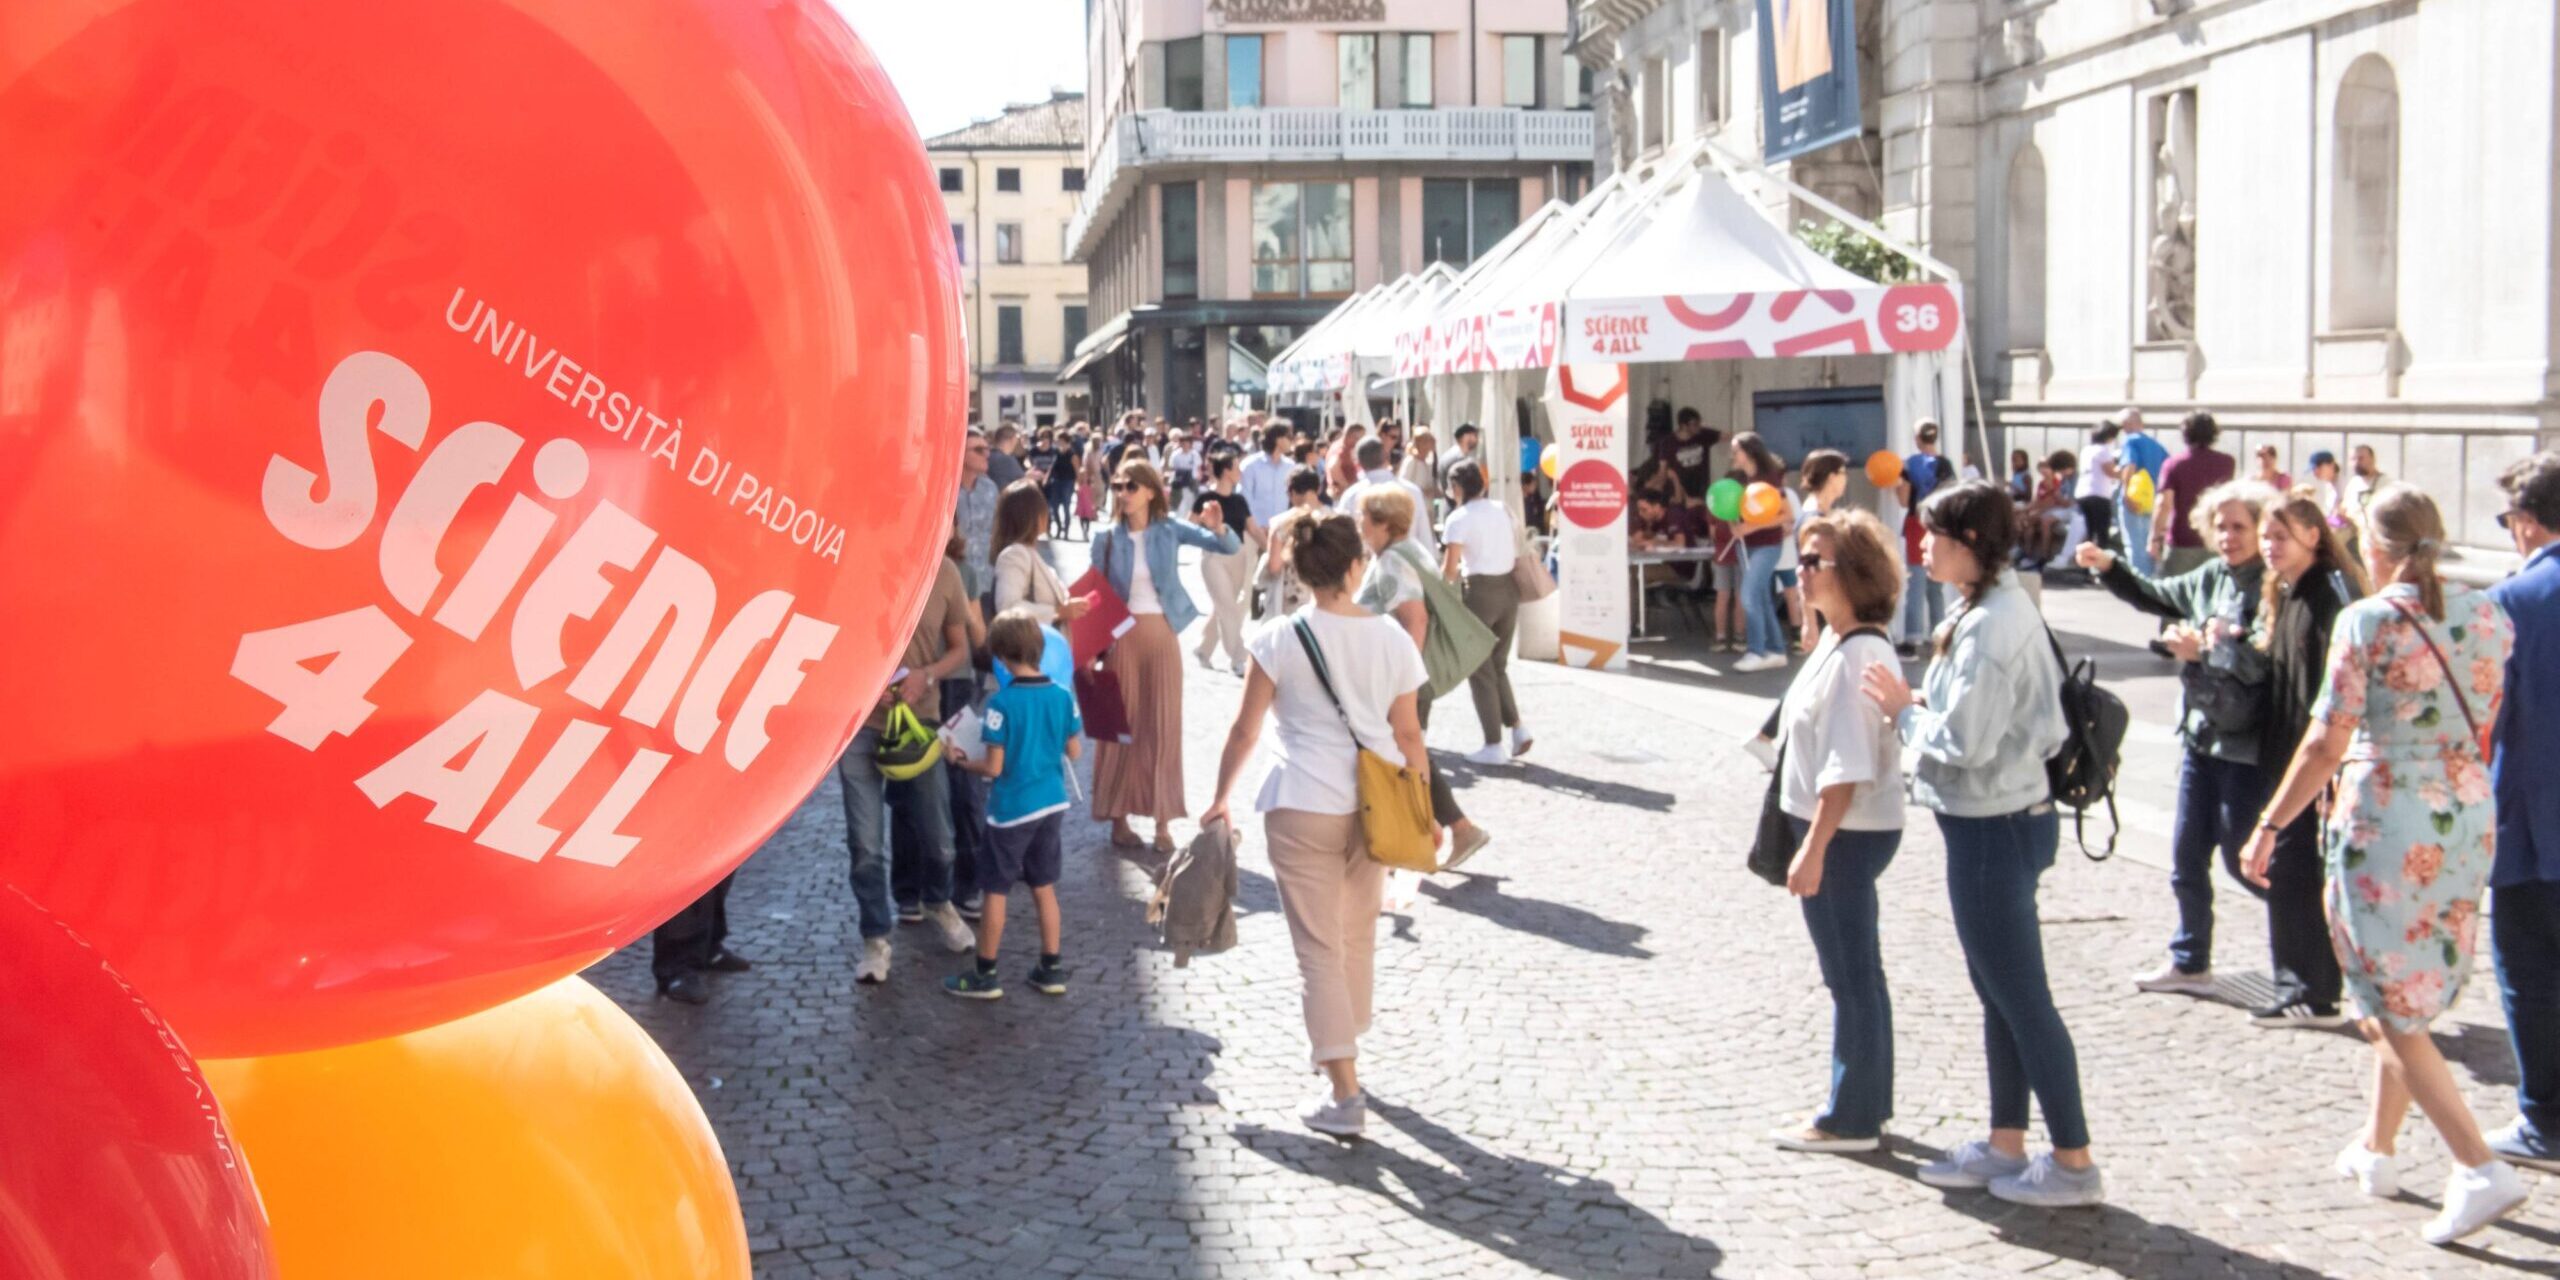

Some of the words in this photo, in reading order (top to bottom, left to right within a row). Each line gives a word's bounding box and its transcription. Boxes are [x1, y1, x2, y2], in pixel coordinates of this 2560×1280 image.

[1895, 303, 1940, 333] 36
[1593, 338, 1605, 353] 4
[1610, 336, 1642, 354] ALL
[445, 287, 683, 471] UNIVERSITÀ
[688, 447, 732, 496] DI
[729, 472, 846, 564] PADOVA
[1576, 438, 1584, 449] 4
[1587, 438, 1608, 450] ALL
[229, 604, 414, 752] 4
[353, 687, 674, 867] ALL
